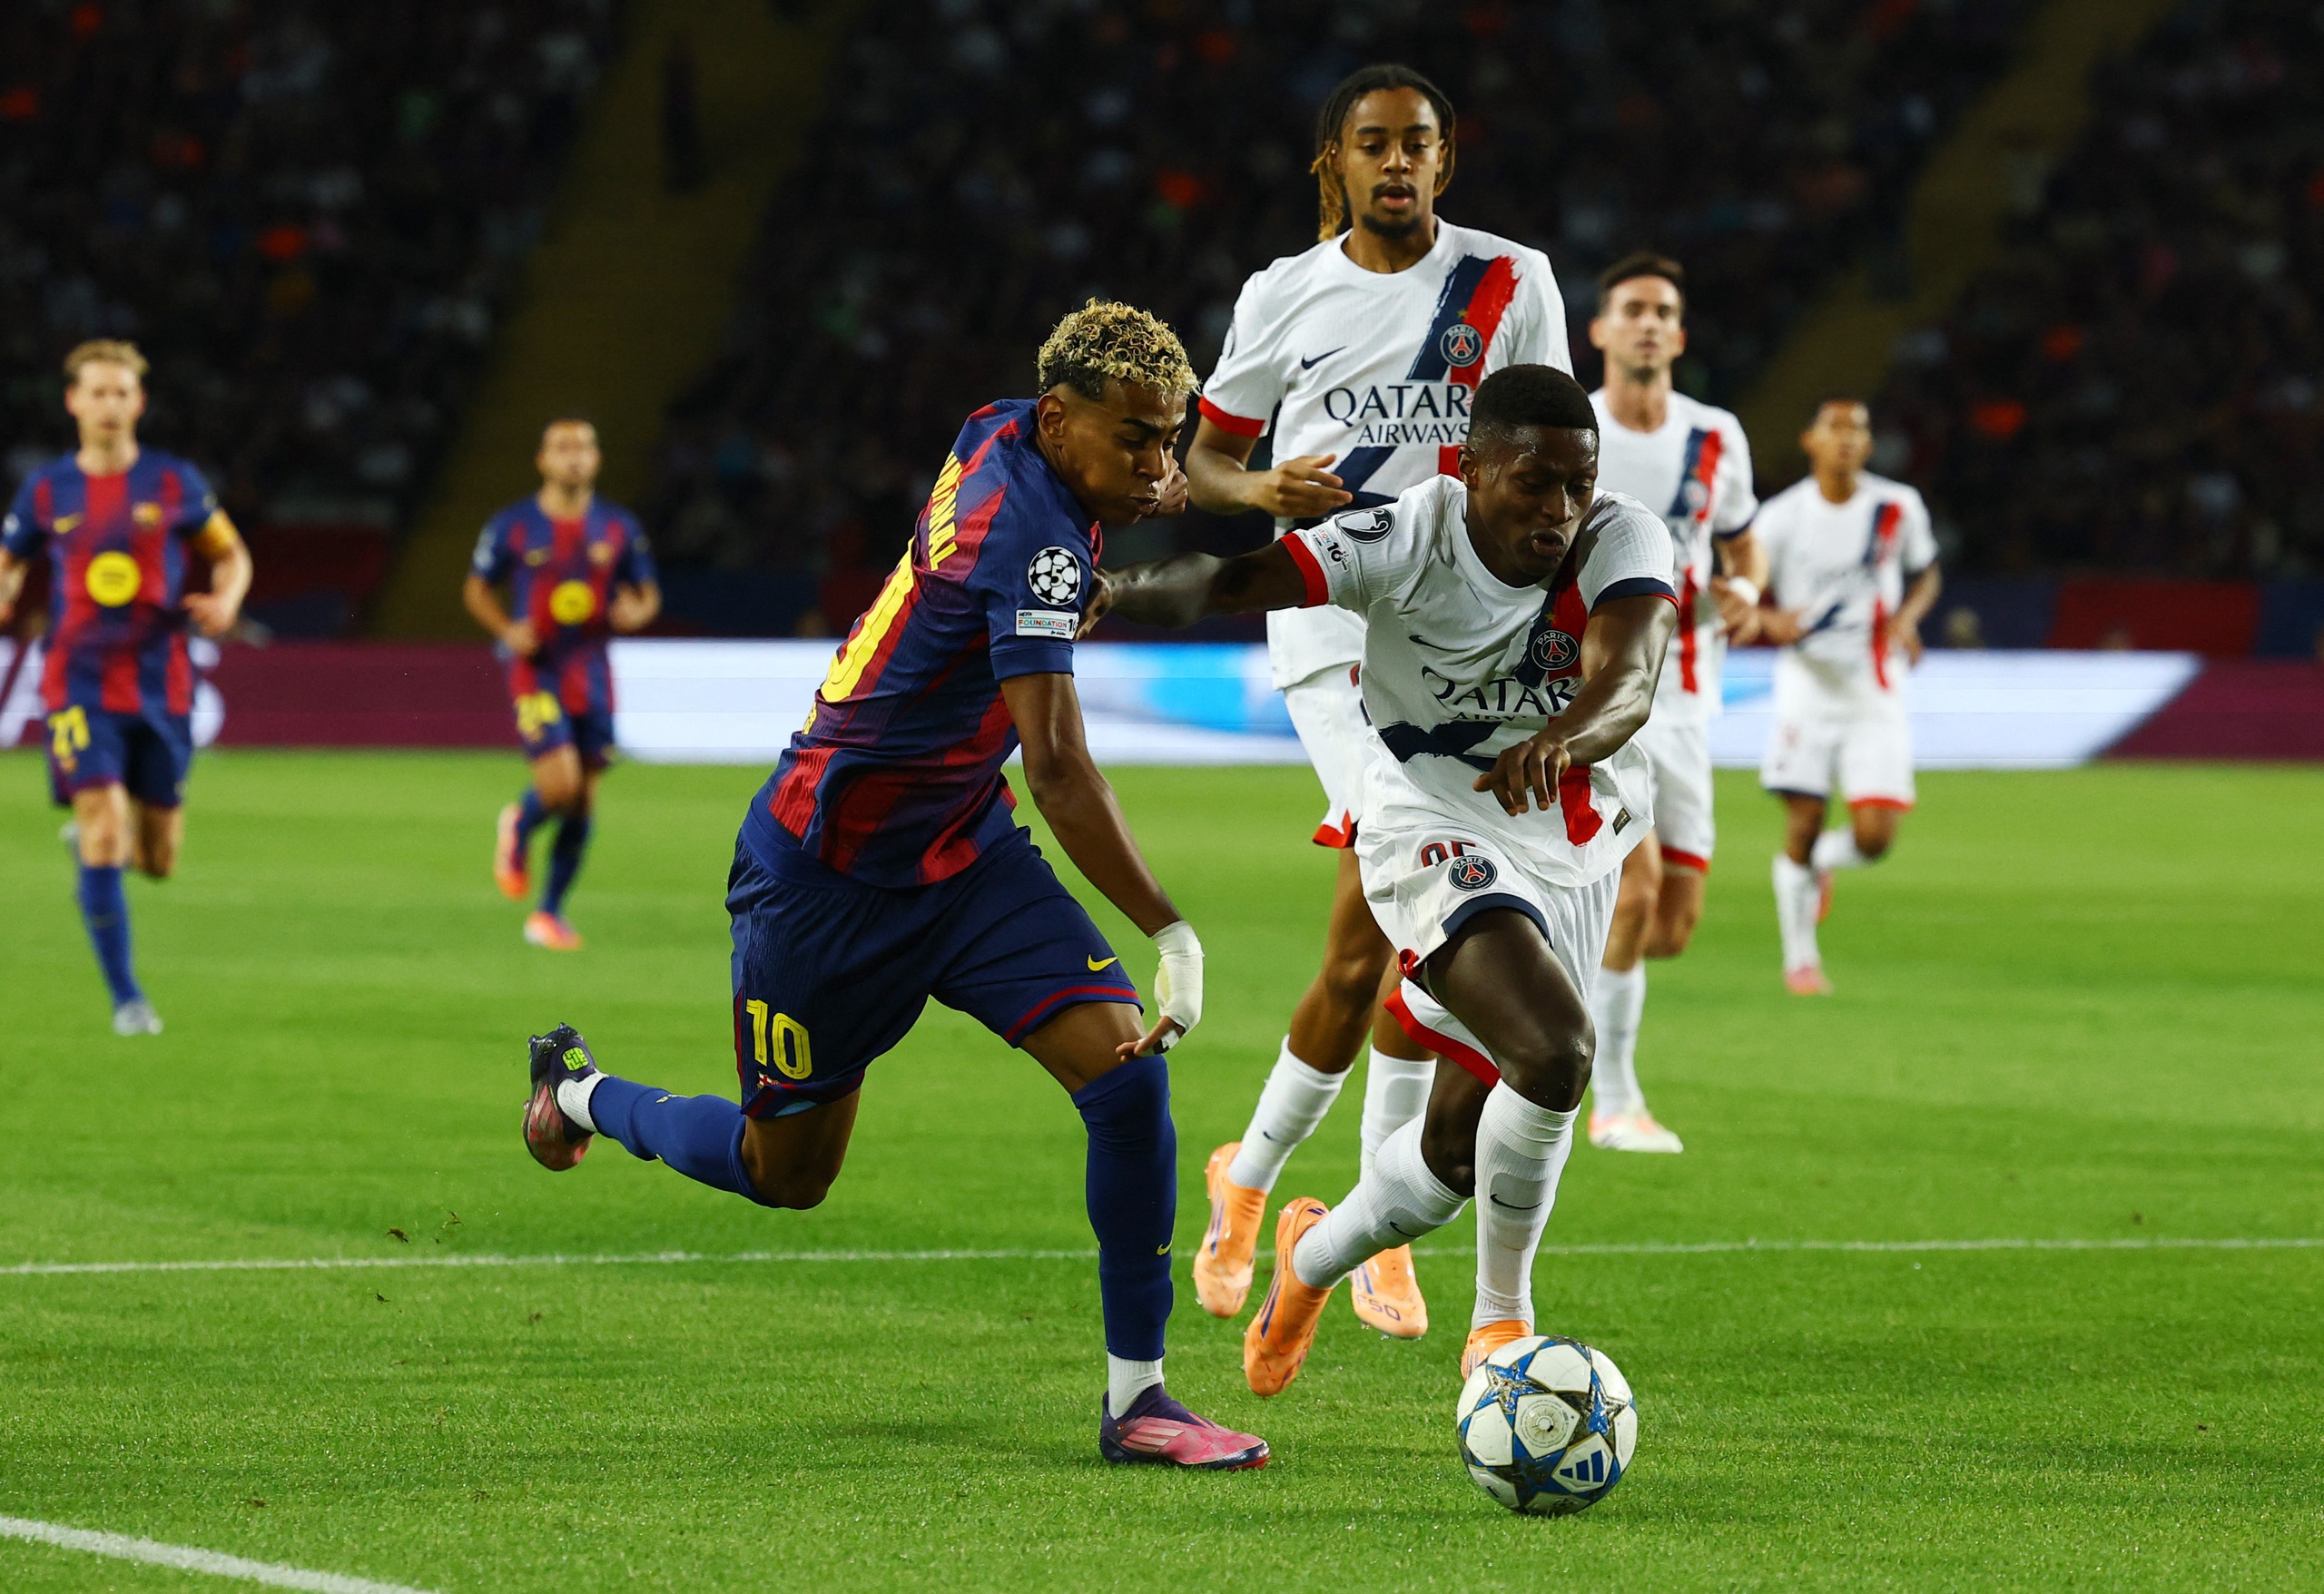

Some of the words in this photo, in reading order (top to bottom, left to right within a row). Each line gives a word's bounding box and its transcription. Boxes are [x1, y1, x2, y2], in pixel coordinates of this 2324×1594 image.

[1324, 385, 1468, 428] QATAR
[1358, 423, 1470, 444] AIRWAYS
[1050, 565, 1064, 588] 5
[1019, 620, 1068, 629] FOUNDATION
[1537, 632, 1568, 645] PARIS
[1422, 665, 1576, 716] QATAR
[1454, 858, 1484, 870] PARIS
[746, 999, 812, 1080] 10
[1356, 1294, 1401, 1321] F50
